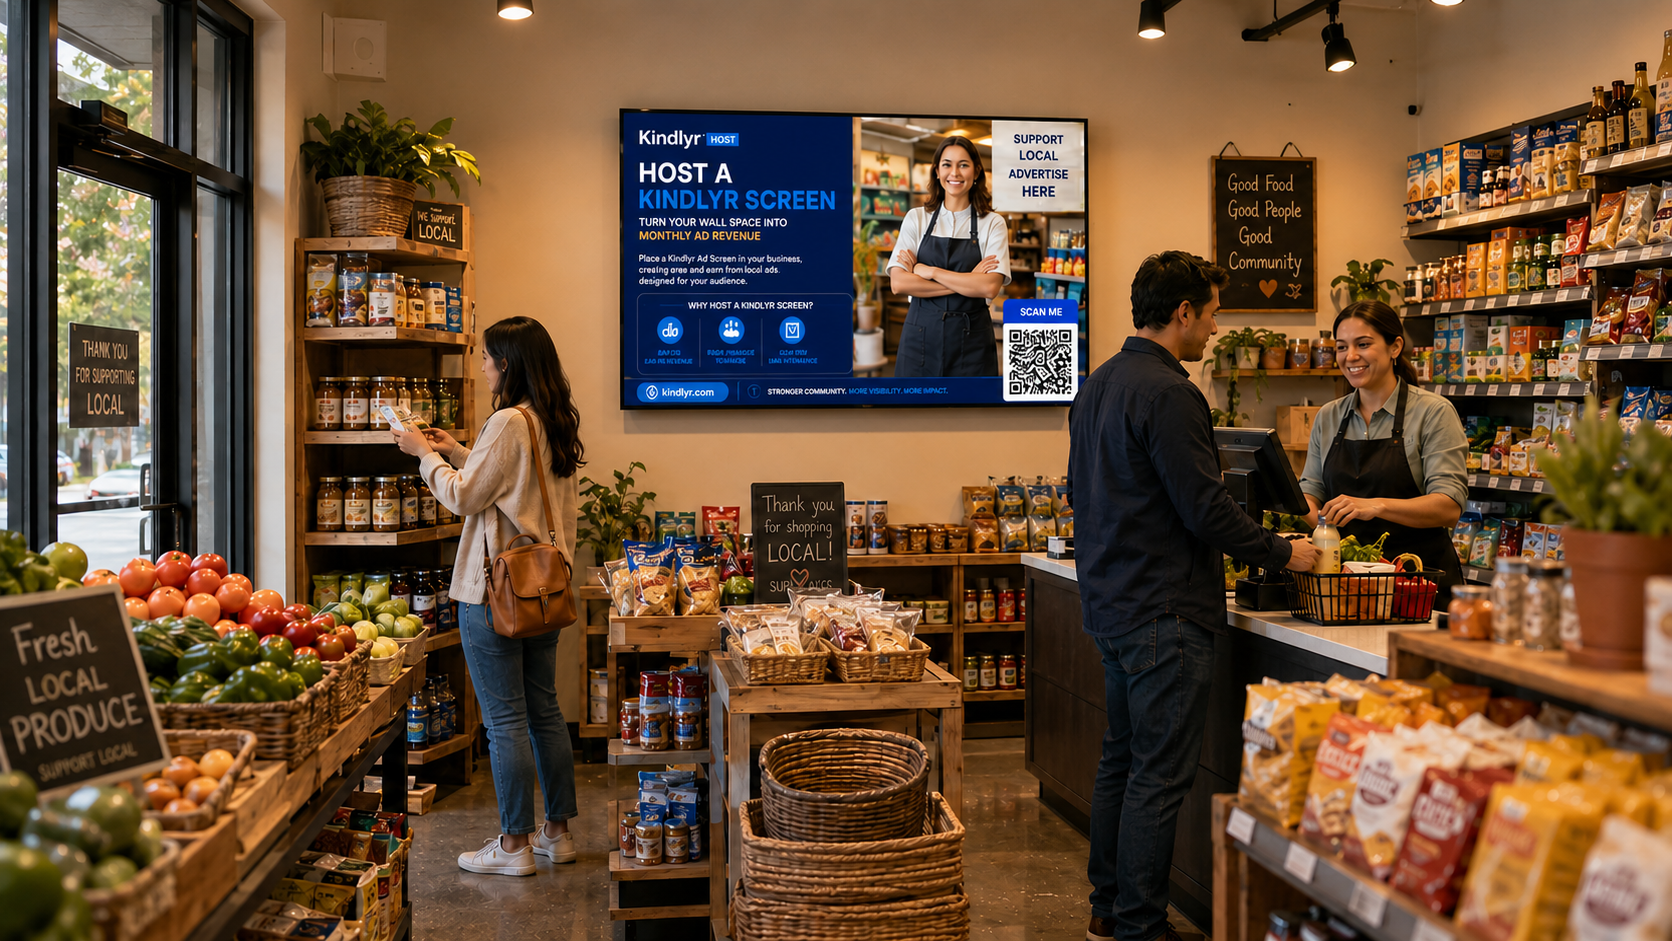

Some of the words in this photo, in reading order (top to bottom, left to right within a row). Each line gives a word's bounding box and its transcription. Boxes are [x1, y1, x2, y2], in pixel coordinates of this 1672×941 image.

[639, 130, 701, 149] Kindlyr
[710, 136, 736, 144] HOST
[1013, 134, 1064, 144] SUPPORT
[1020, 150, 1058, 161] LOCAL
[639, 162, 708, 184] HOST
[714, 163, 733, 184] A
[1008, 169, 1069, 180] ADVERTISE
[1022, 185, 1056, 198] HERE
[1228, 172, 1259, 194] Good
[1266, 174, 1294, 192] Food
[639, 189, 739, 210] KINDLYR
[745, 190, 836, 210] SCREEN
[417, 210, 428, 222] WE
[1228, 199, 1260, 220] Good
[1265, 200, 1302, 224] People
[639, 217, 666, 227] TURN
[668, 217, 696, 227] YOUR
[698, 217, 727, 227] WALL
[729, 218, 762, 227] SPACE
[764, 218, 788, 227] INTO
[419, 224, 456, 242] LOCAL
[639, 231, 692, 240] MONTHLY
[694, 231, 710, 240] AD
[712, 231, 761, 241] REVENUE
[1239, 226, 1273, 247] Good
[638, 254, 660, 262] Place
[668, 254, 696, 264] Kindlyr
[697, 254, 708, 262] Ad
[710, 254, 736, 262] Screen
[738, 254, 746, 262] in
[747, 256, 766, 264] your
[1229, 251, 1302, 278] Community
[690, 265, 704, 274] and
[726, 265, 744, 274] from
[744, 265, 762, 274] local
[638, 276, 675, 287] designed
[677, 276, 688, 284] for
[690, 278, 708, 287] your
[710, 276, 748, 285] audience.
[688, 301, 708, 310] WHY
[710, 301, 732, 310] HOST
[734, 301, 740, 310] A
[776, 301, 814, 310] SCREEN?
[1020, 308, 1046, 316] SCAN
[1048, 308, 1063, 316] ME
[82, 340, 110, 358] THANK
[112, 342, 128, 360] YOU
[76, 366, 90, 383] FOR
[92, 368, 136, 385] SUPPORTING
[662, 388, 714, 399] kindlyr.com
[87, 392, 124, 415] LOCAL
[762, 494, 806, 512] Thank
[812, 501, 835, 518] you
[764, 518, 781, 534] for
[786, 520, 832, 539] shopping
[768, 541, 832, 562] LOCAL!
[10, 616, 98, 666] Fresh
[25, 666, 109, 705] LOCAL
[9, 692, 144, 755] PRODUCE
[38, 751, 96, 782] SUPPORT
[99, 741, 138, 765] LOCAL
